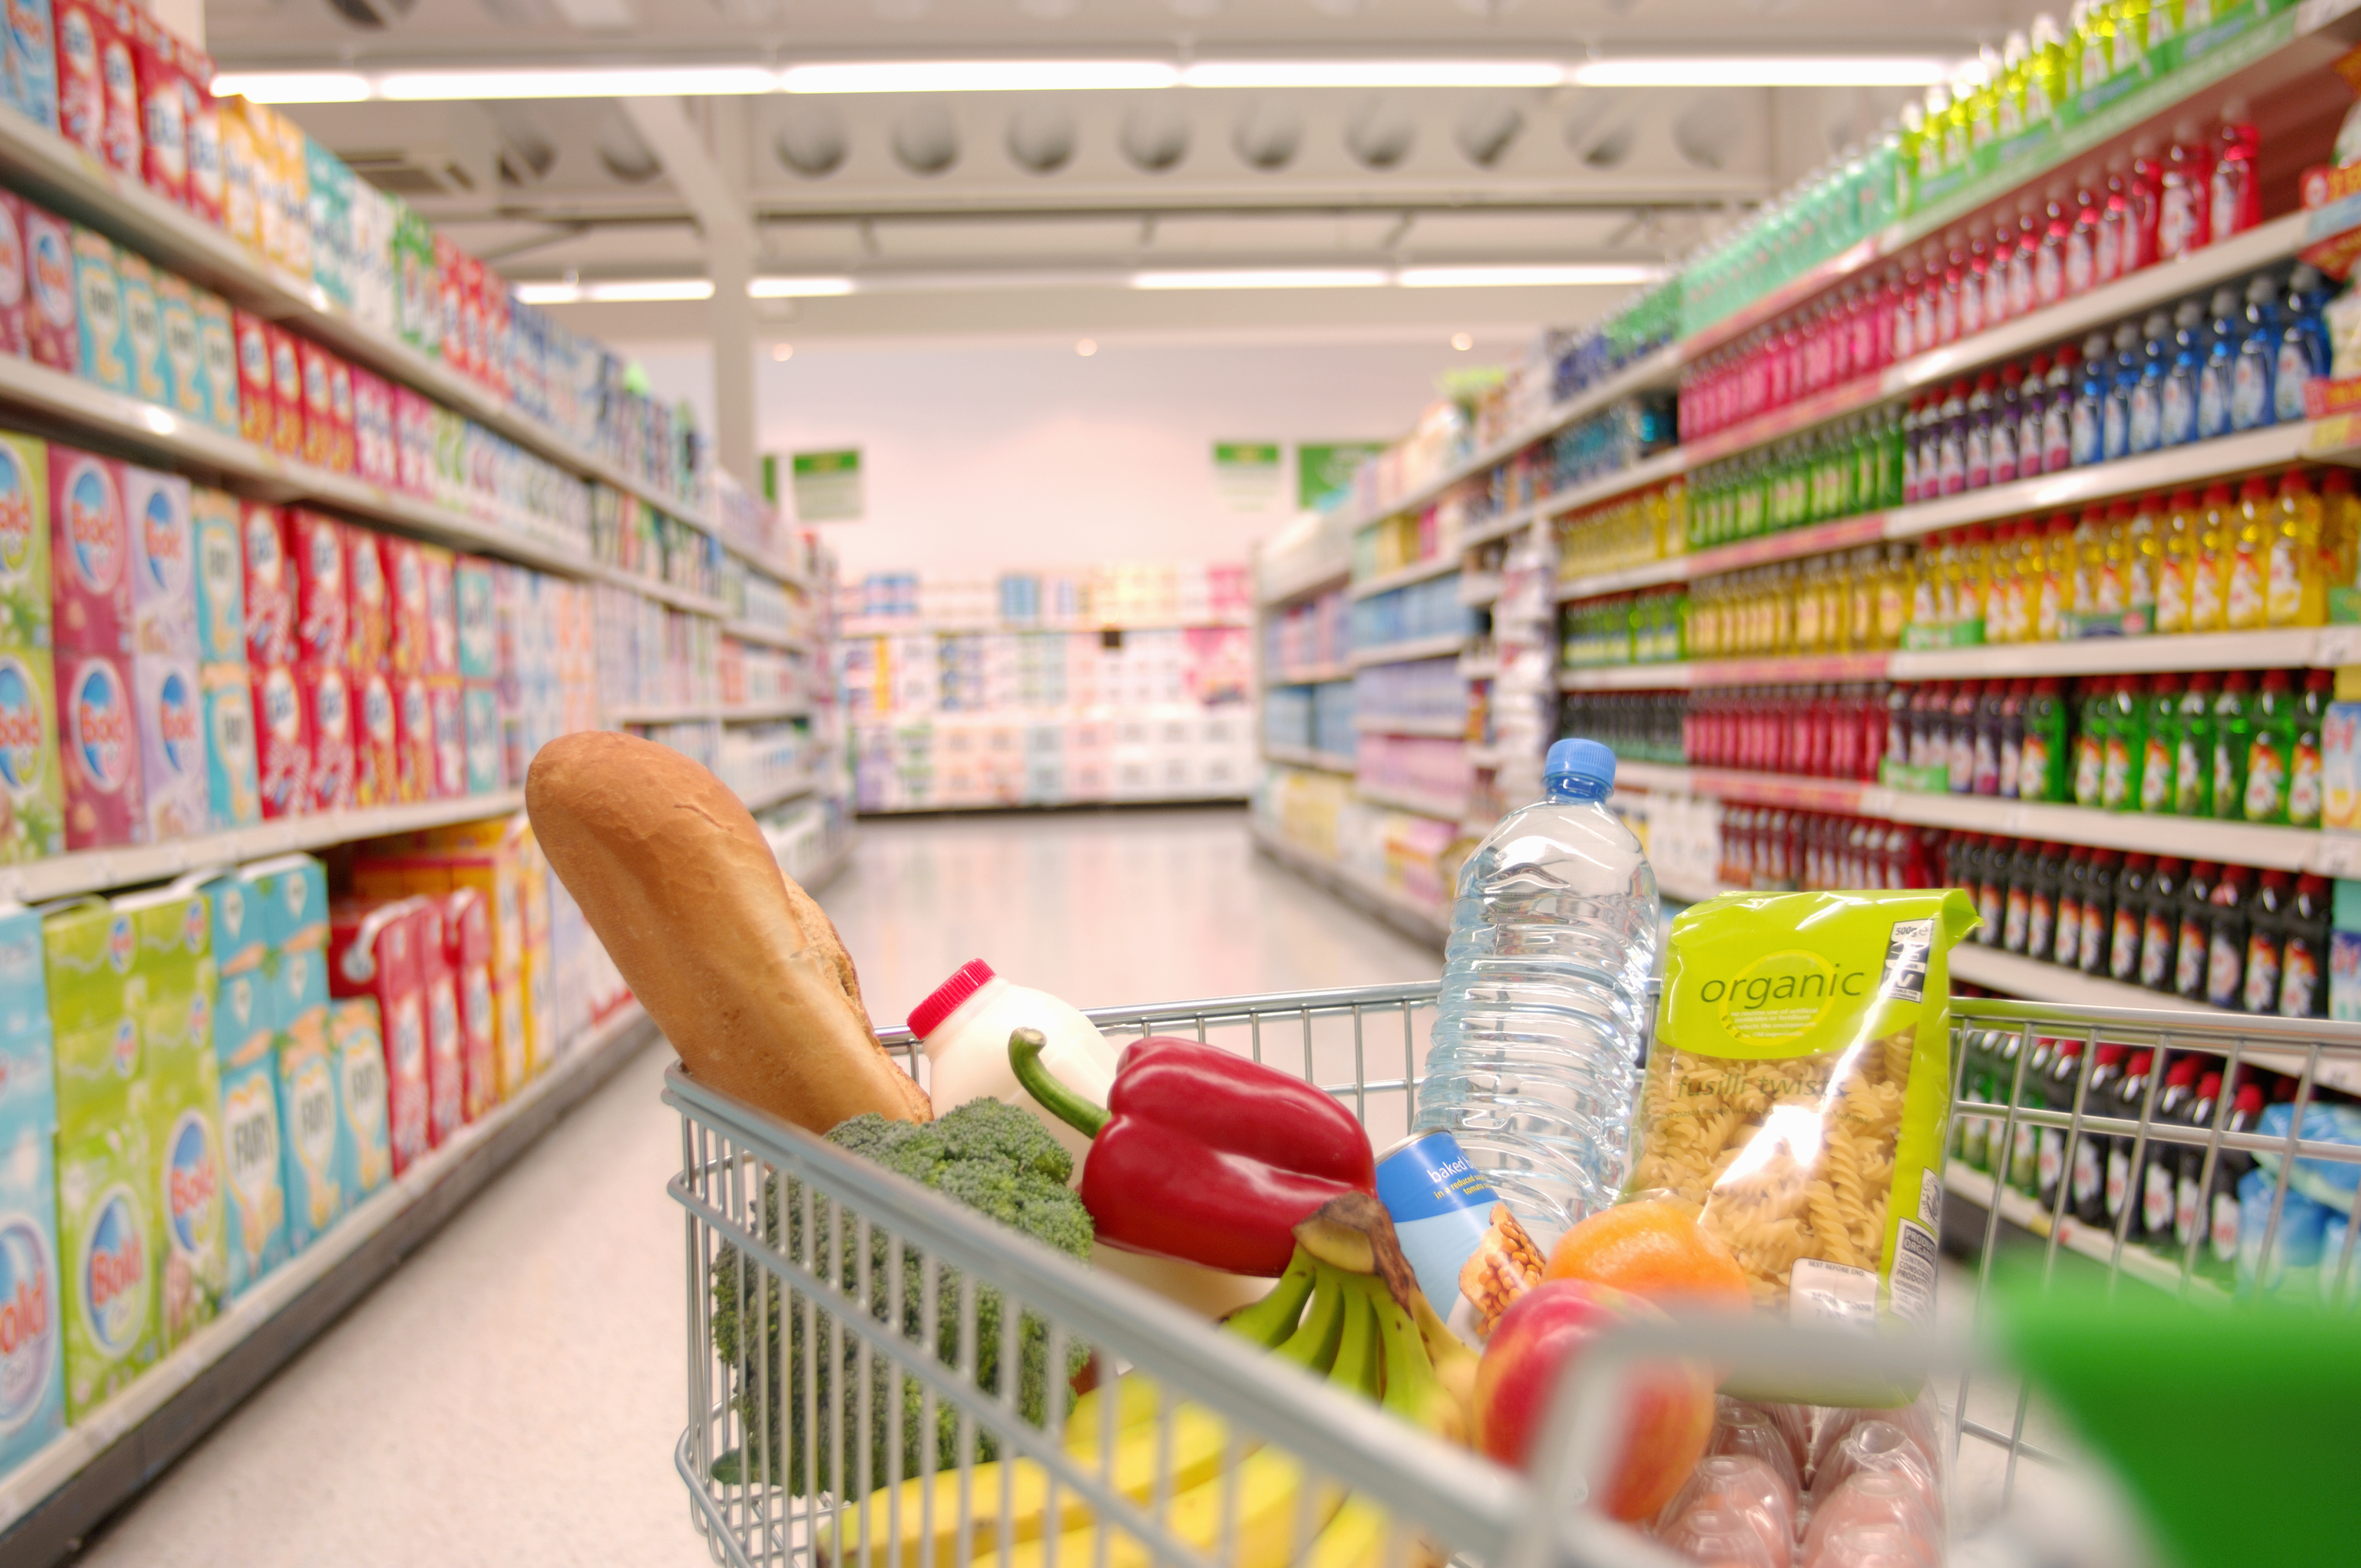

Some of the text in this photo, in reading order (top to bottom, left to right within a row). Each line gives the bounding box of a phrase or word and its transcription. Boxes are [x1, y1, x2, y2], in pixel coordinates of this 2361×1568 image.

[1700, 963, 1864, 1009] organic
[1677, 1073, 1847, 1098] fusilli twists
[1426, 1156, 1468, 1184] baked
[1433, 1190, 1445, 1200] in
[1444, 1186, 1451, 1194] a
[1450, 1174, 1476, 1191] reduced
[1463, 1182, 1484, 1196] tomato
[1905, 1228, 1936, 1254] PRODUC
[90, 1232, 143, 1309] Bold
[1808, 1260, 1823, 1268] BEST
[1825, 1263, 1849, 1273] BEFORE
[0, 1271, 46, 1355] old
